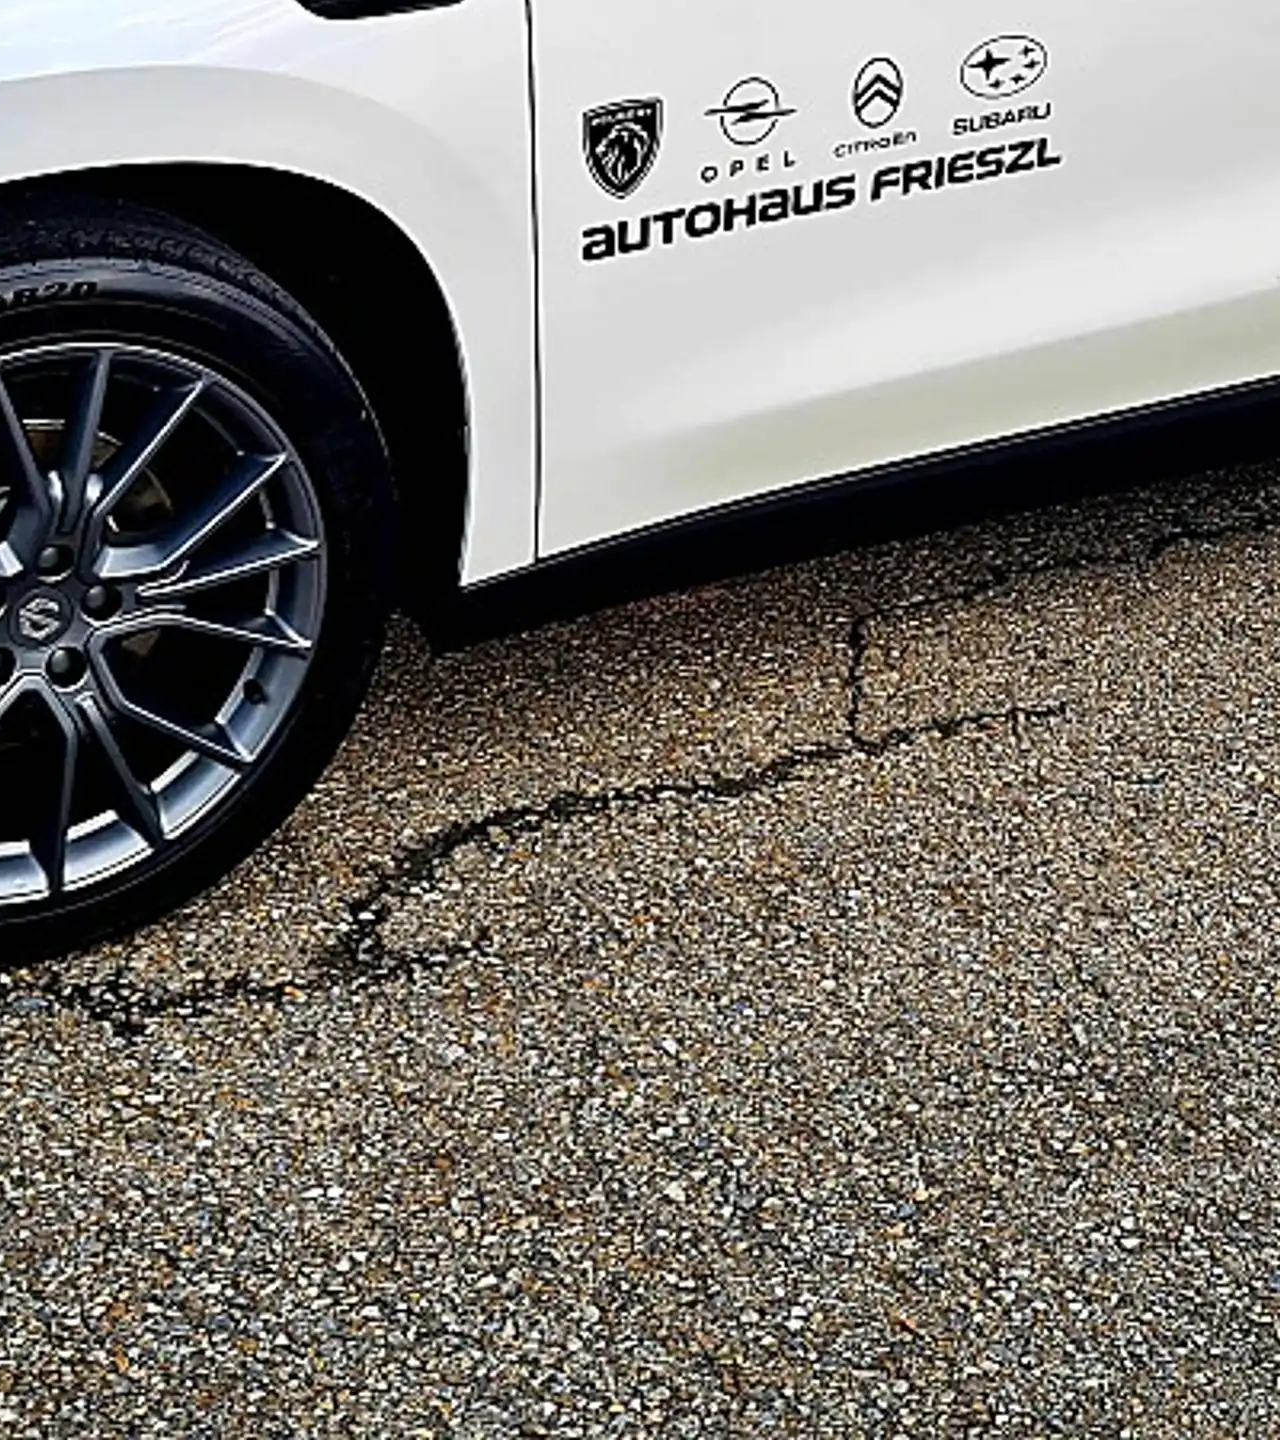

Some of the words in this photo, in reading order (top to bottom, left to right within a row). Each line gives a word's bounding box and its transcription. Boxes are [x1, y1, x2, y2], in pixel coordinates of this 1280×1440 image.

[953, 102, 1051, 136] SUBARU
[700, 150, 795, 184] OPEL
[870, 137, 1061, 202] FRIESZL
